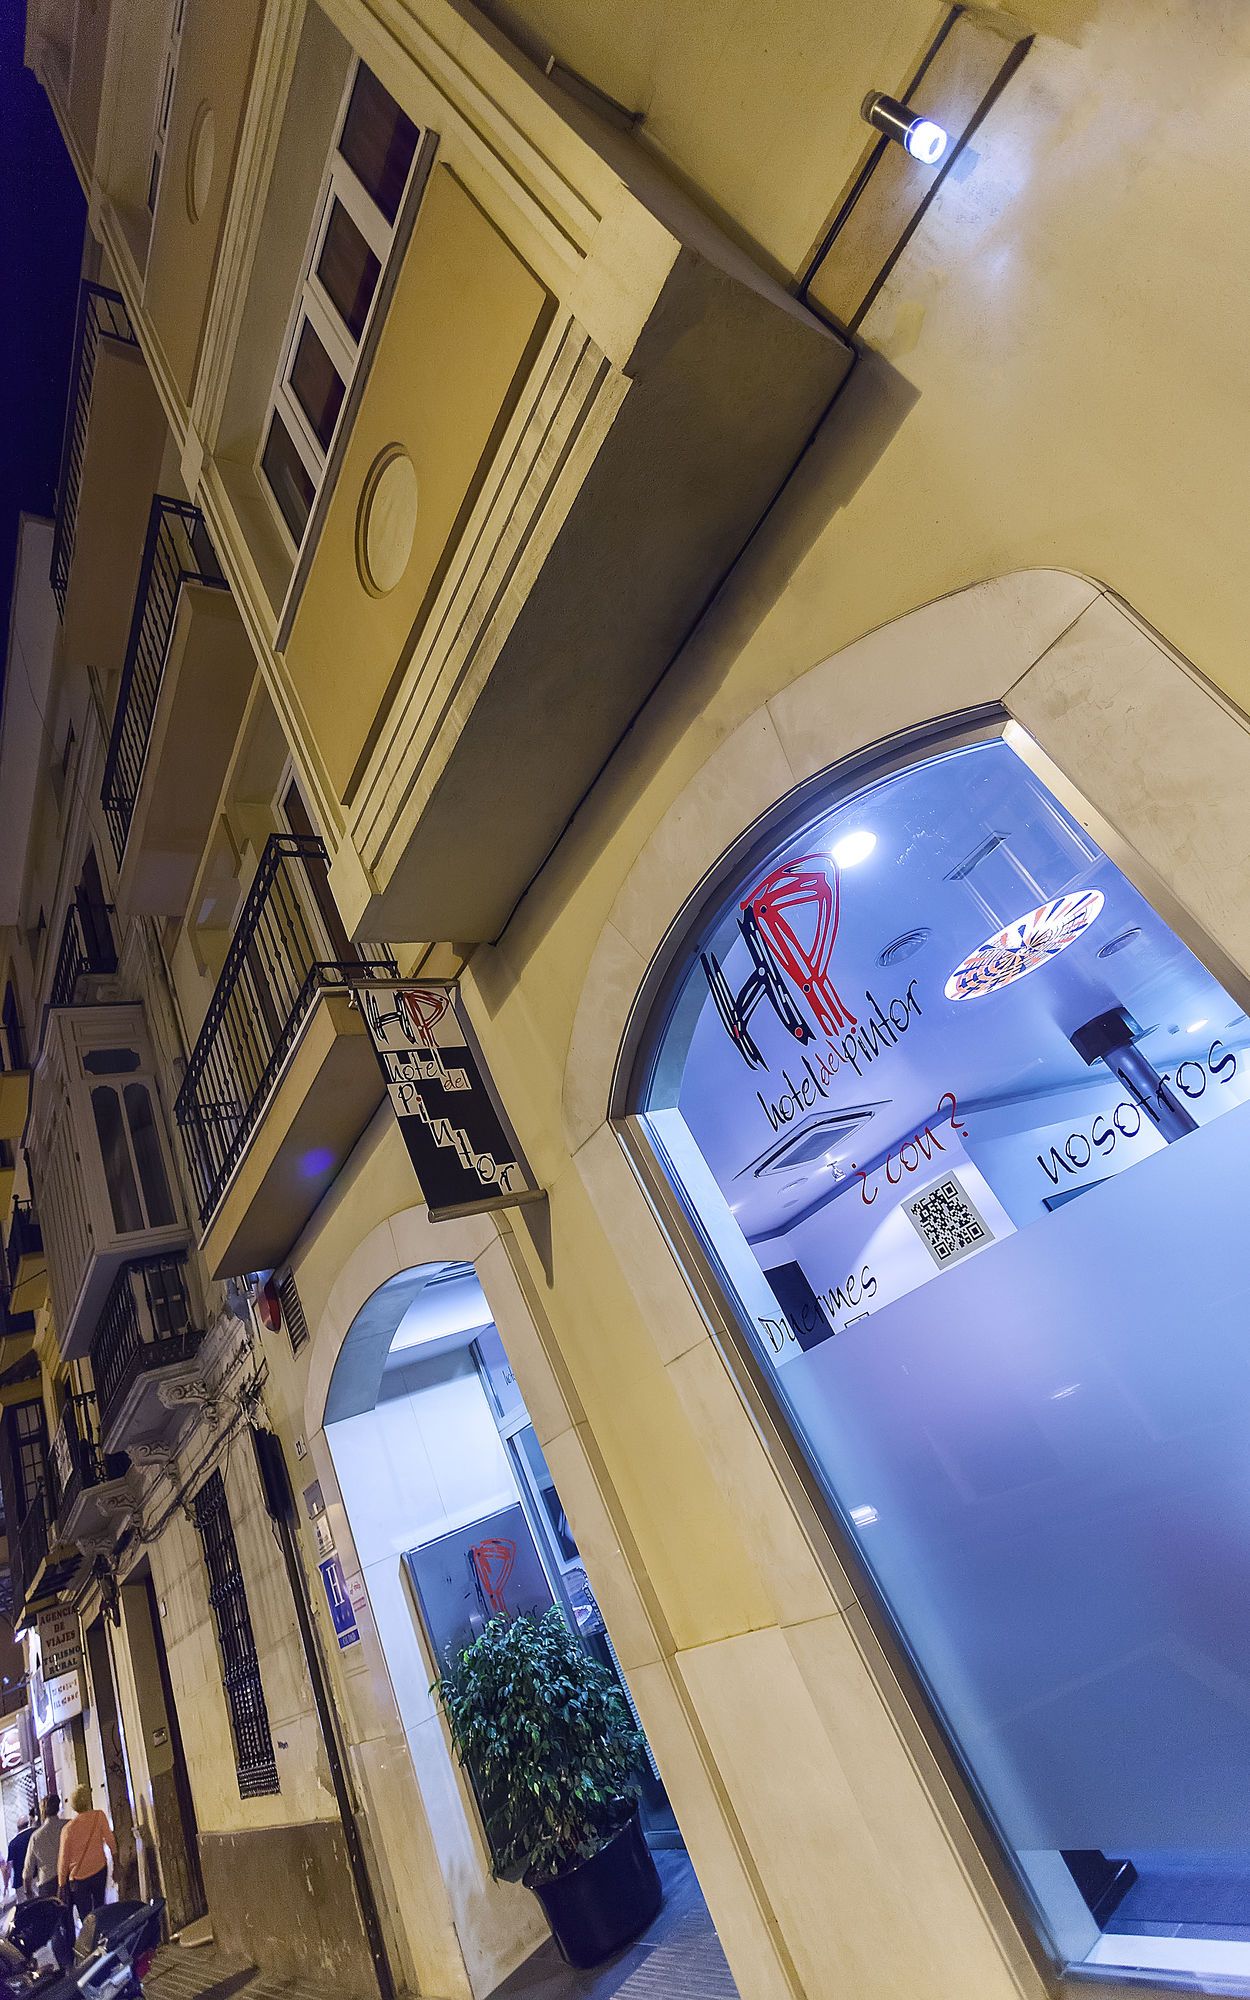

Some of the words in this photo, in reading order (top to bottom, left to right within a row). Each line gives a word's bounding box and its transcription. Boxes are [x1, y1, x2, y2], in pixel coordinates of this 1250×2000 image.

[325, 1563, 345, 1607] H
[40, 1604, 78, 1625] AGENCIA
[53, 1622, 66, 1633] DE
[46, 1630, 76, 1648] VIAJES
[43, 1645, 81, 1666] TURISMO
[49, 1658, 78, 1675] RURAL
